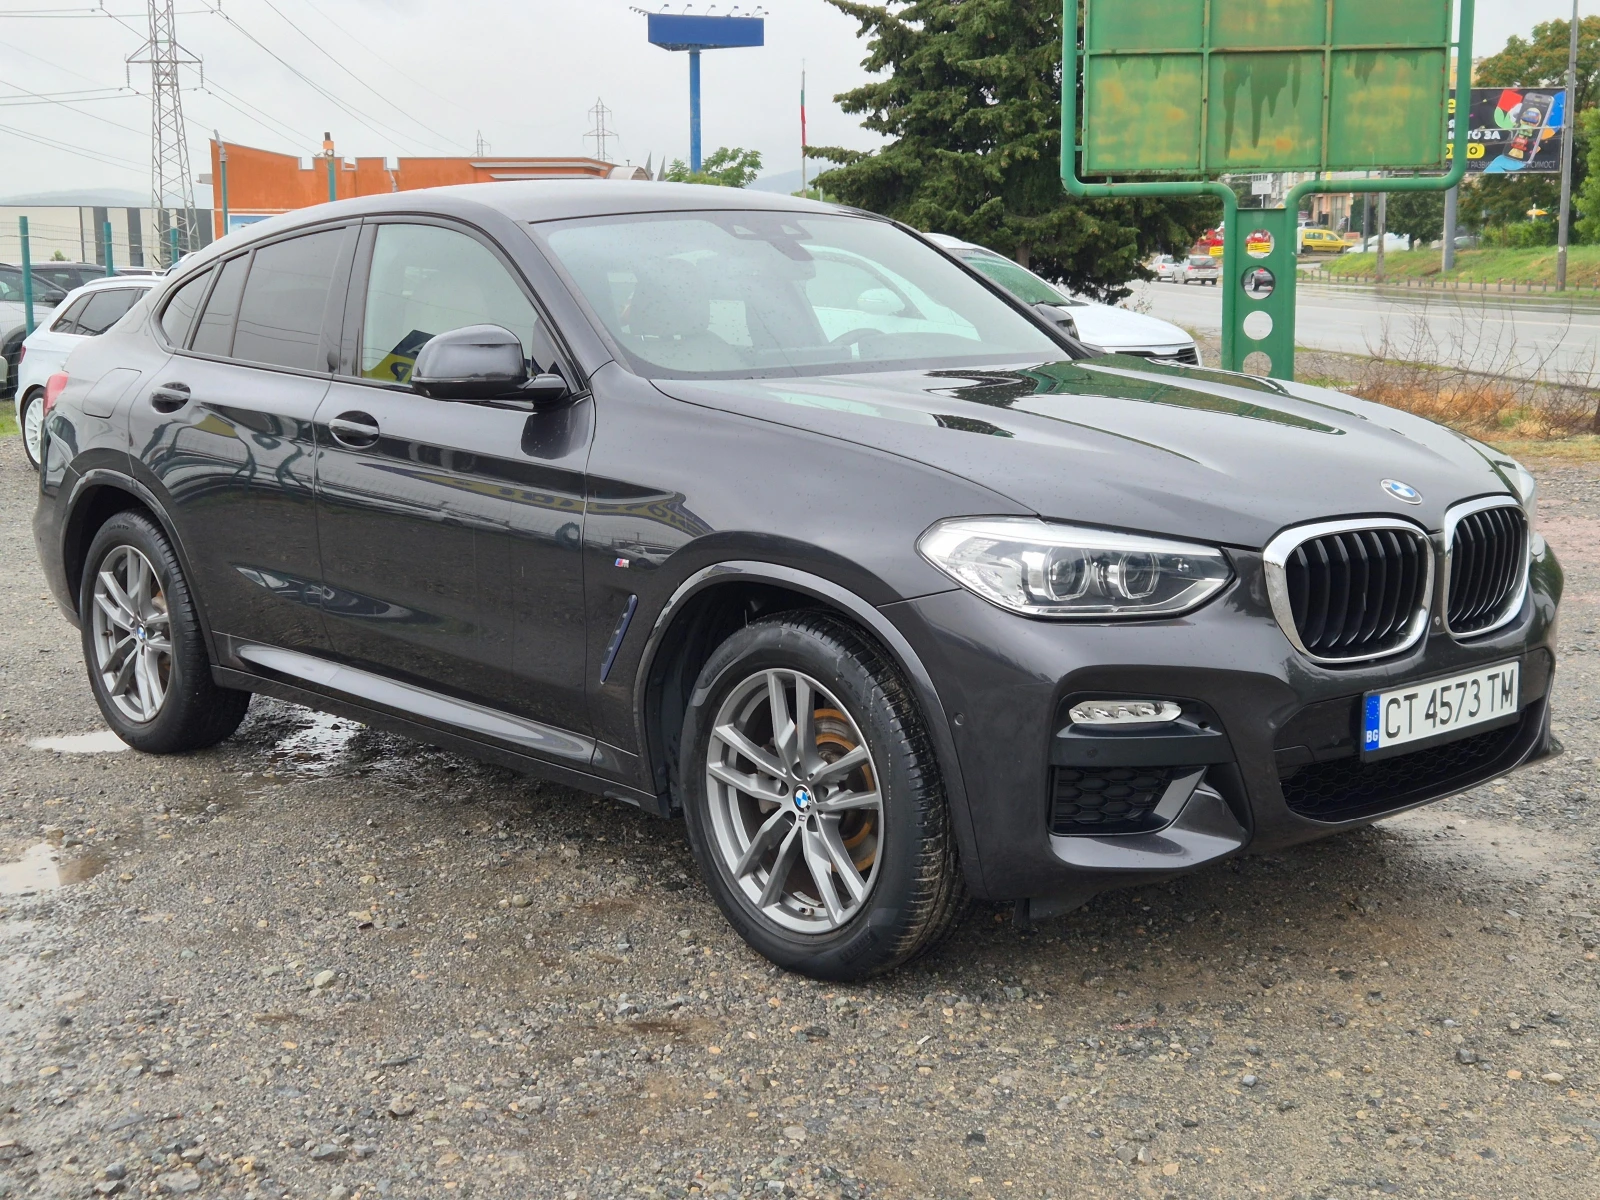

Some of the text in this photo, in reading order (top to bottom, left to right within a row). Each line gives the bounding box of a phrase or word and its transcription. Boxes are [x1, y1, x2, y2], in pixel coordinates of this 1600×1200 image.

[1483, 130, 1501, 140] ЗА
[1385, 669, 1514, 739] CT 4573 TM
[1366, 730, 1379, 743] BG
